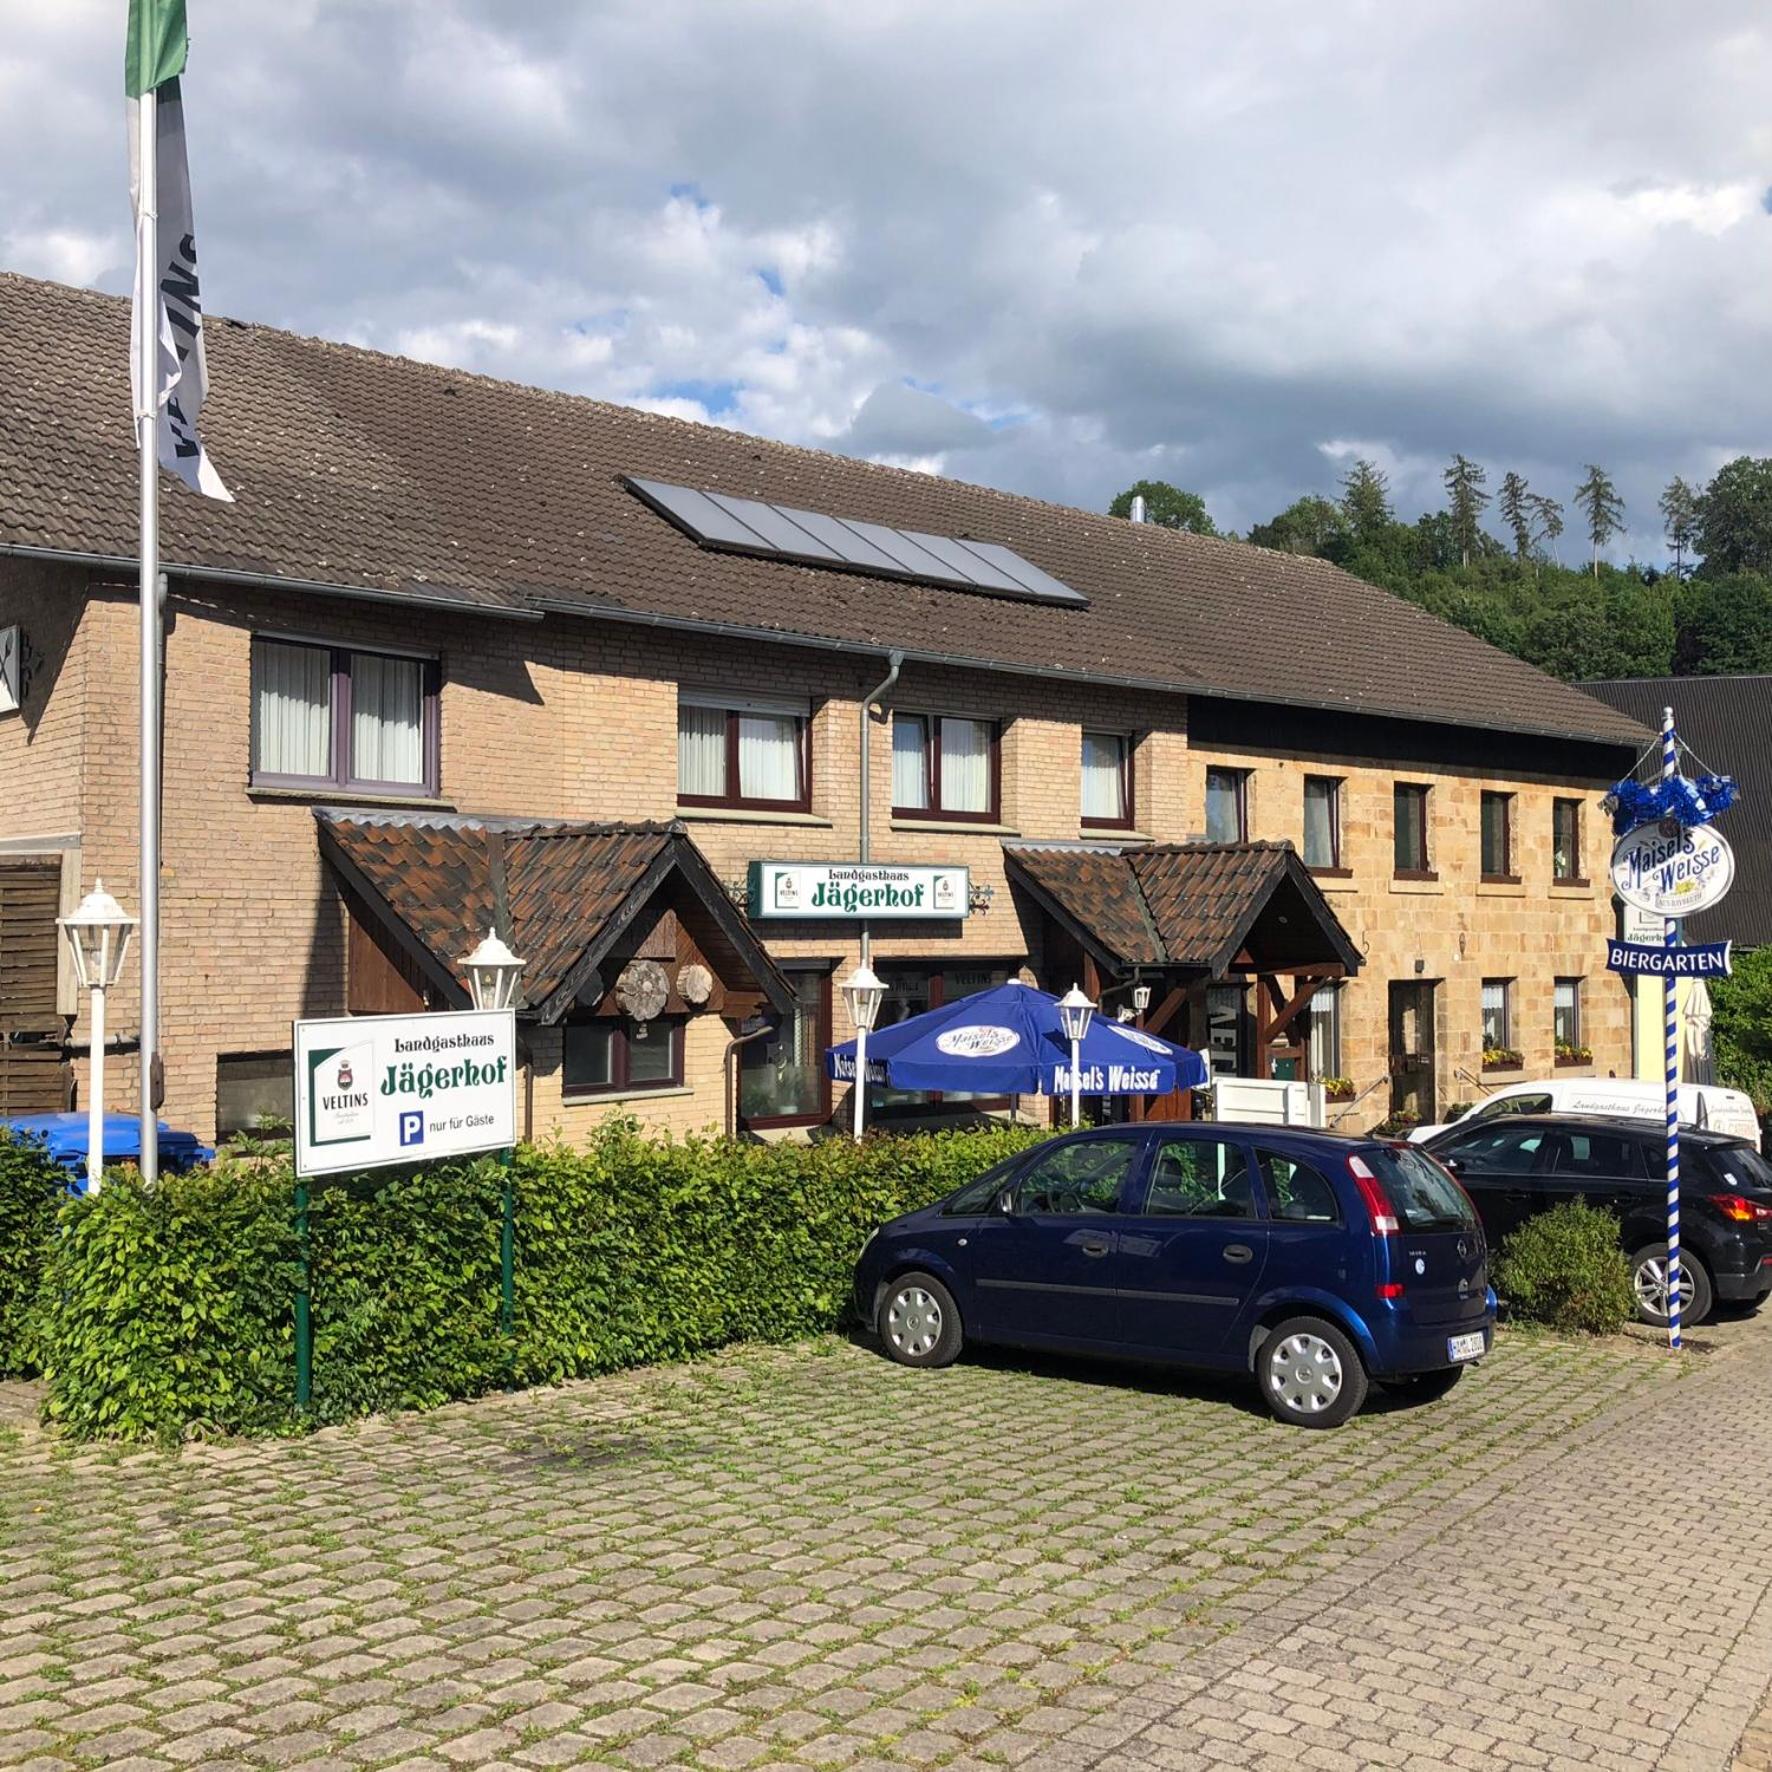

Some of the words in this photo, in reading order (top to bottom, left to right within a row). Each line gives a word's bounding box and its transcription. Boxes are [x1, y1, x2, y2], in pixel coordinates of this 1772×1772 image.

[828, 869, 910, 883] Landgasthaus
[1653, 845, 1720, 893] Weisse
[811, 881, 925, 912] Jägerhof
[1610, 948, 1724, 972] BIERGARTEN
[394, 1033, 495, 1053] Landgasthaus
[380, 1055, 507, 1099] Jägerhof
[1108, 1065, 1159, 1092] Weisse
[322, 1092, 369, 1111] VELTINS
[404, 1115, 421, 1144] P
[429, 1121, 447, 1133] nur
[449, 1117, 463, 1130] für
[465, 1114, 495, 1127] Gäste
